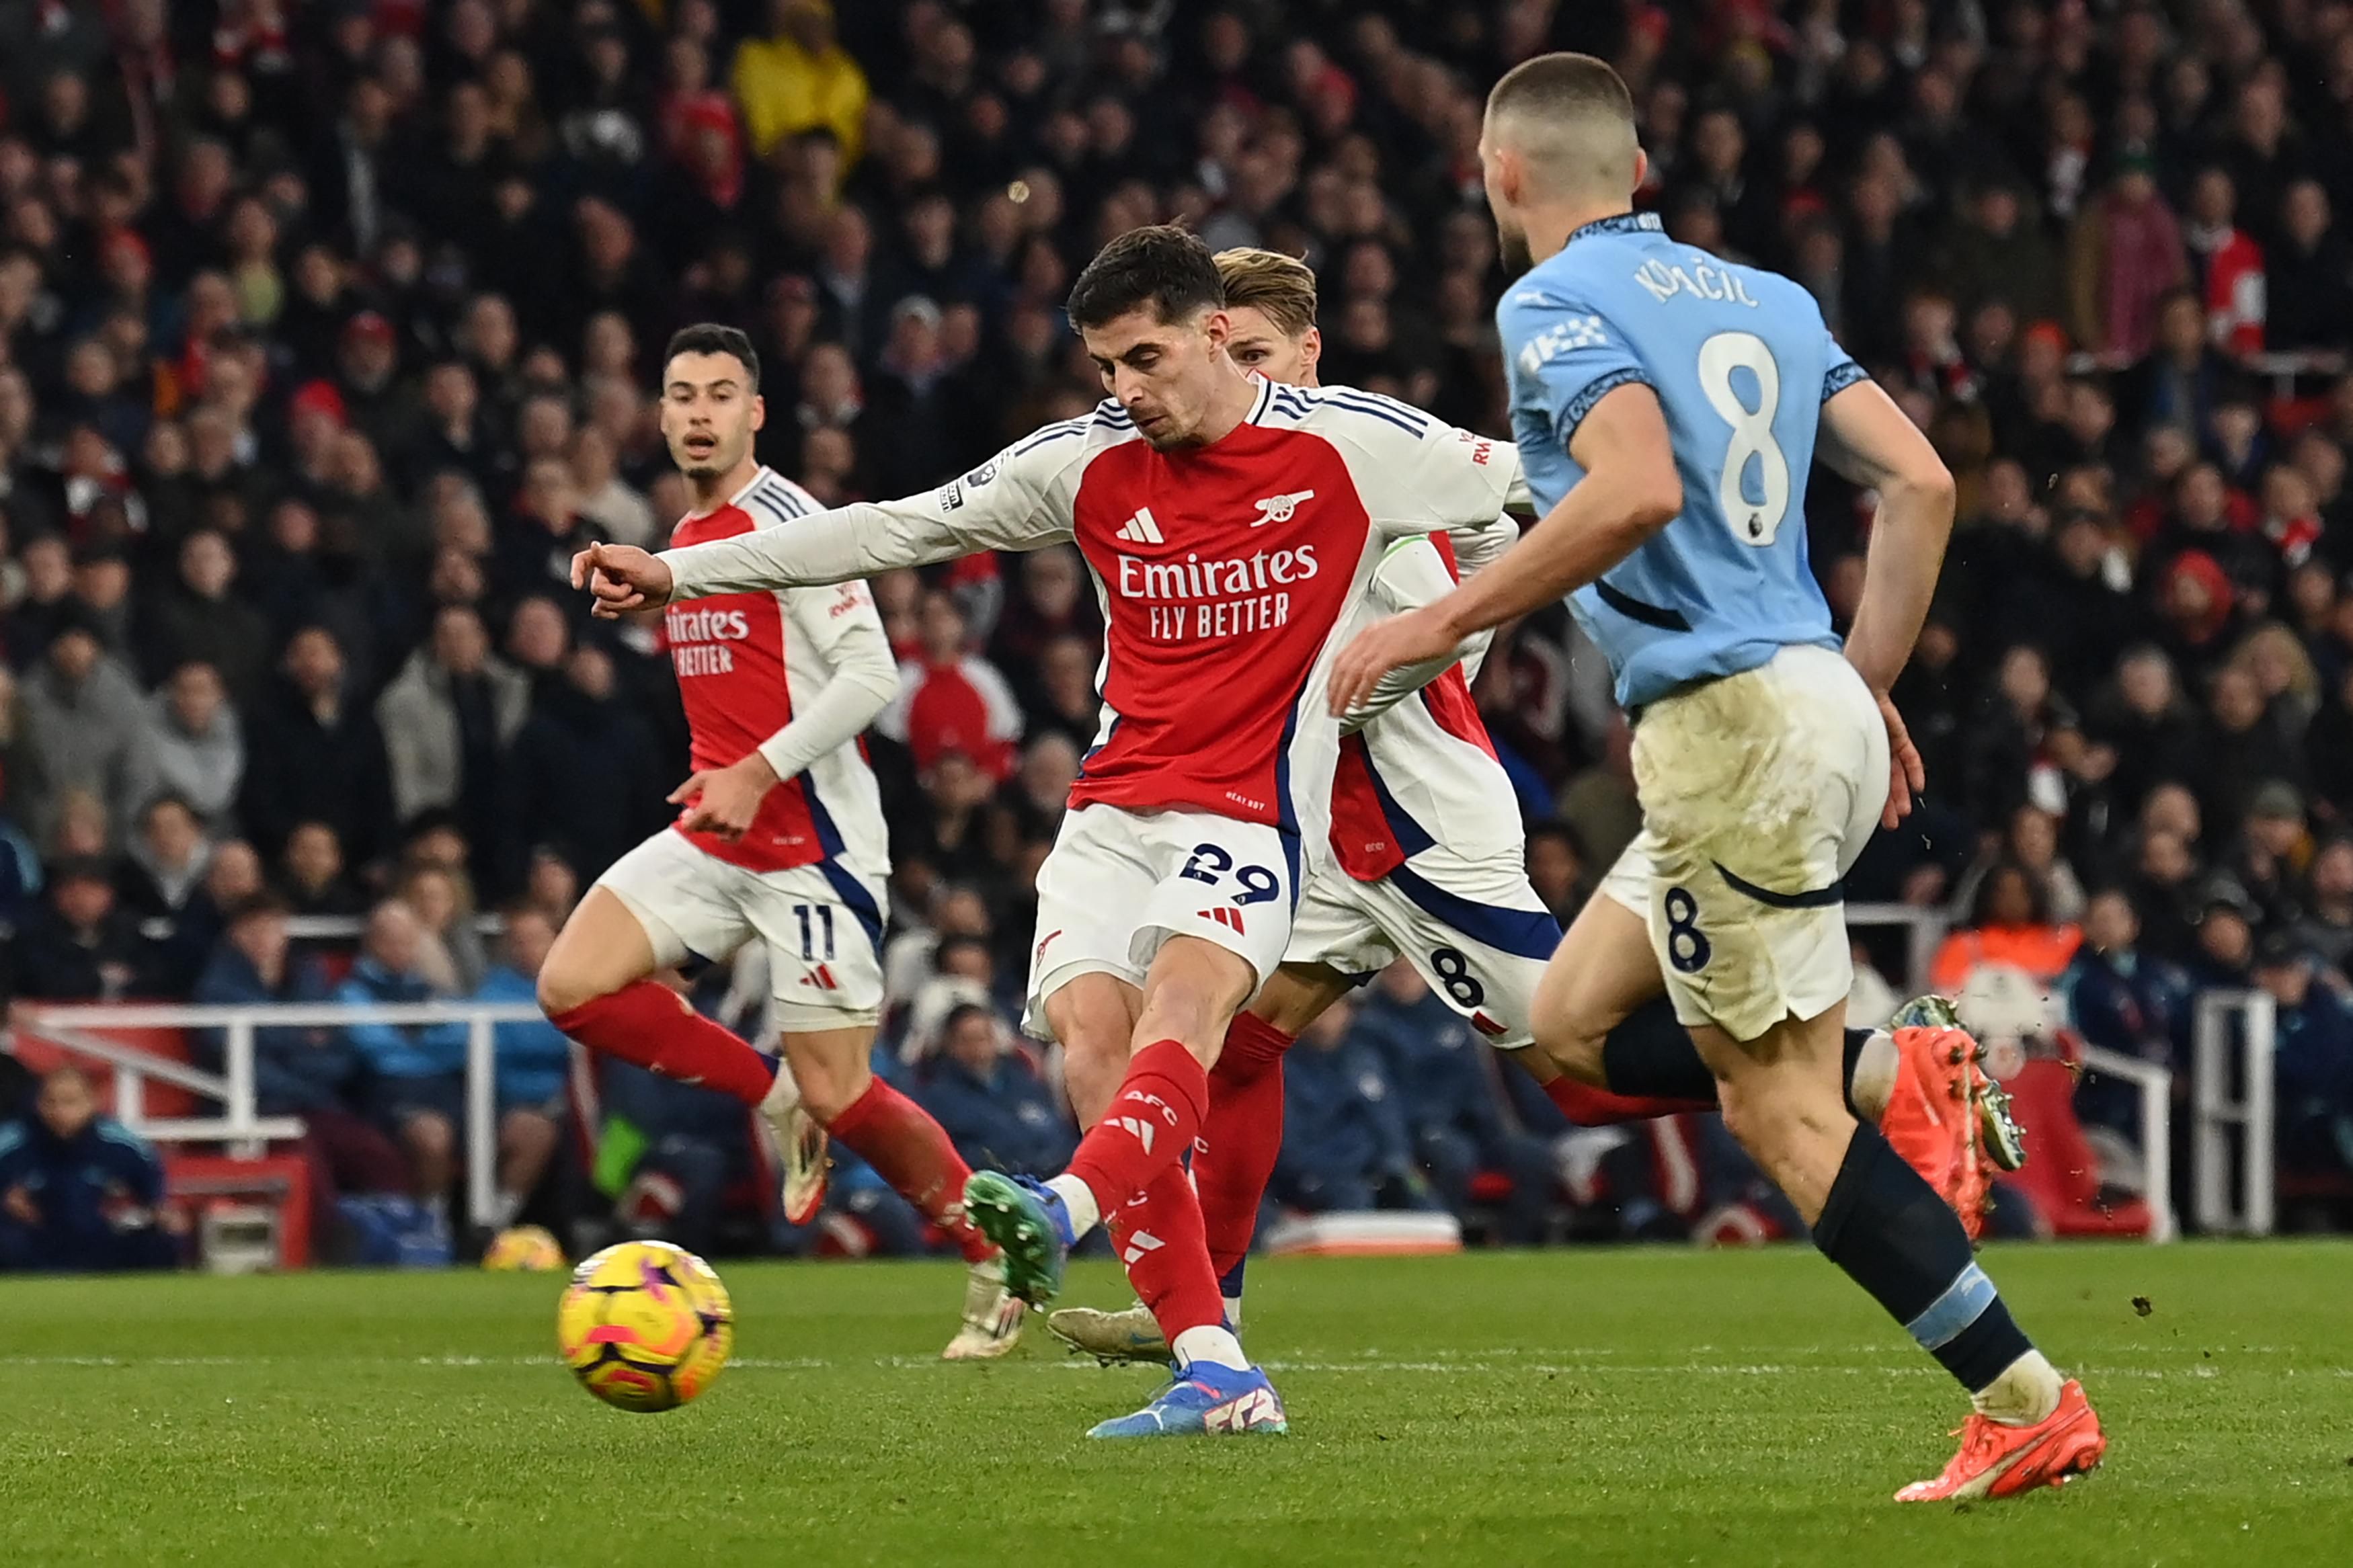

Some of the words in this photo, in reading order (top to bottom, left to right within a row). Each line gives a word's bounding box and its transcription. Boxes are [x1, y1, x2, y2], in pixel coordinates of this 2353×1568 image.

[1698, 331, 1789, 546] 8
[1117, 544, 1318, 599] Emirates
[1150, 606, 1186, 640] FLY
[1197, 591, 1289, 638] BETTER
[677, 645, 734, 677] BETTER
[1178, 843, 1280, 907] 29
[793, 904, 835, 962] 11
[1664, 886, 1712, 974] 8
[1430, 948, 1484, 1009] 8
[1123, 1089, 1179, 1127] AFC
